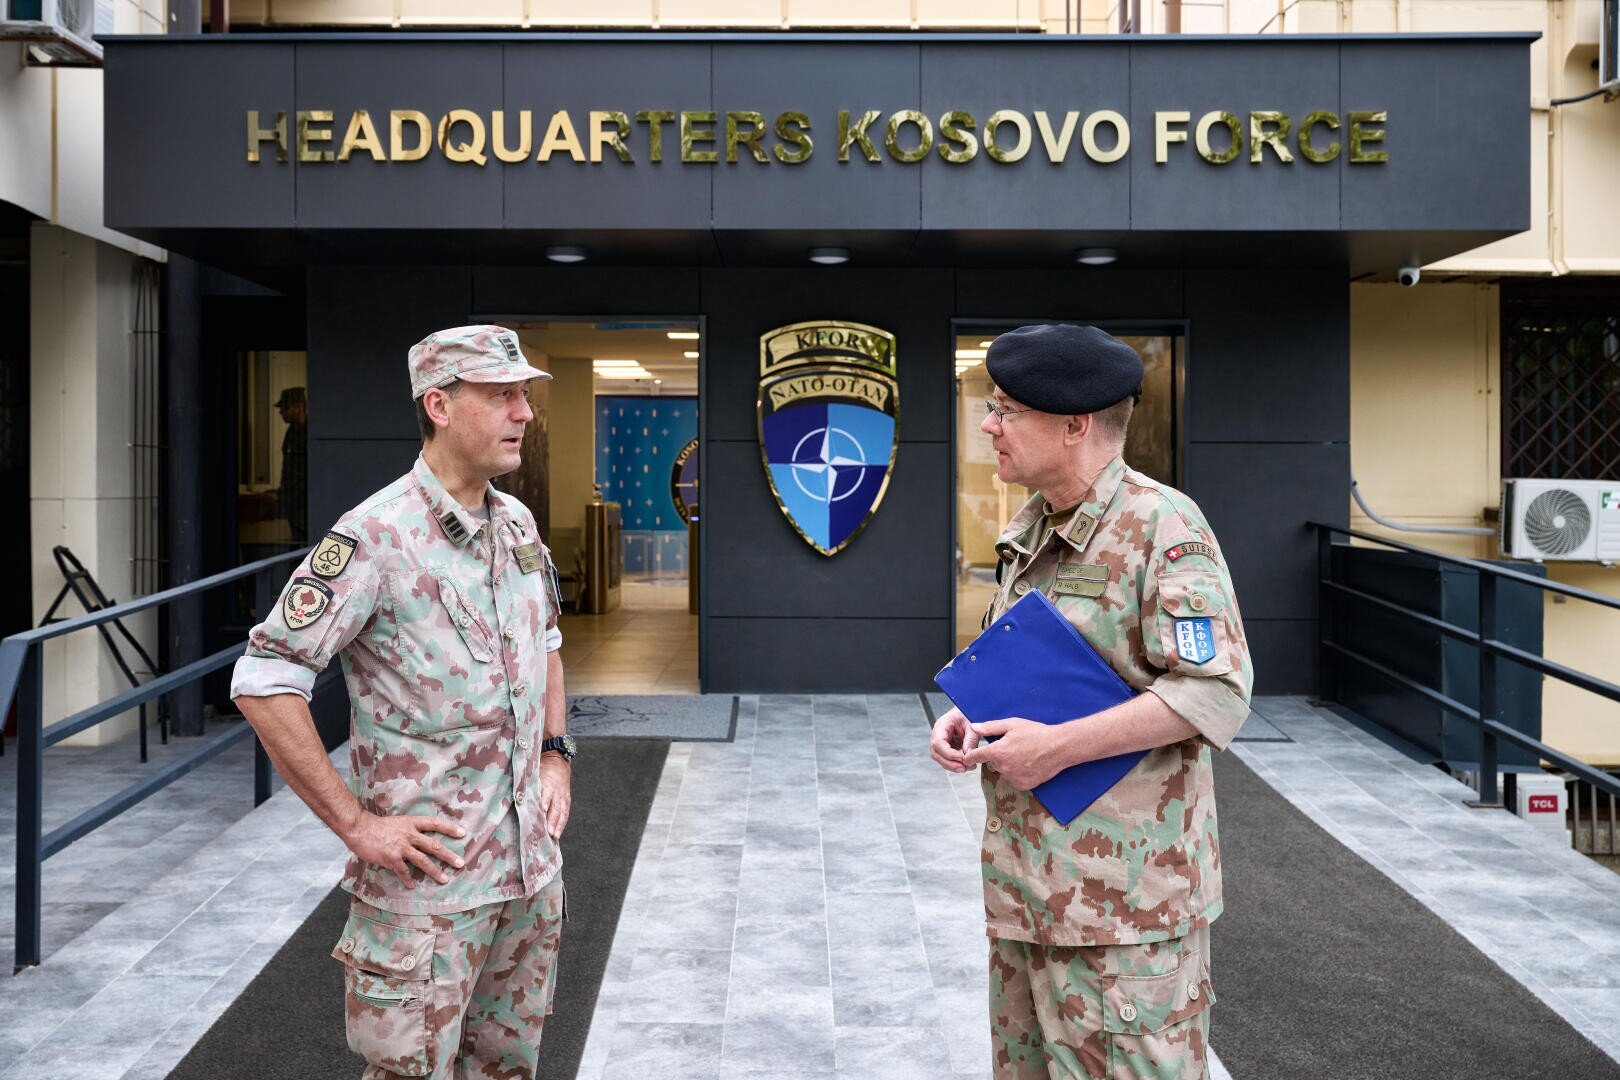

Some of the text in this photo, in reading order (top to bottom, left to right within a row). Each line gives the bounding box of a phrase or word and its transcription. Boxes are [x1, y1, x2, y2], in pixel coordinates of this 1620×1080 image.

[247, 109, 1388, 166] HEADQUARTERS KOSOVO FORCE
[796, 330, 861, 350] KFOR
[771, 378, 886, 403] NATO-OTAN
[320, 563, 331, 572] 46
[1181, 623, 1194, 657] KFOR
[1532, 800, 1554, 808] TCL
